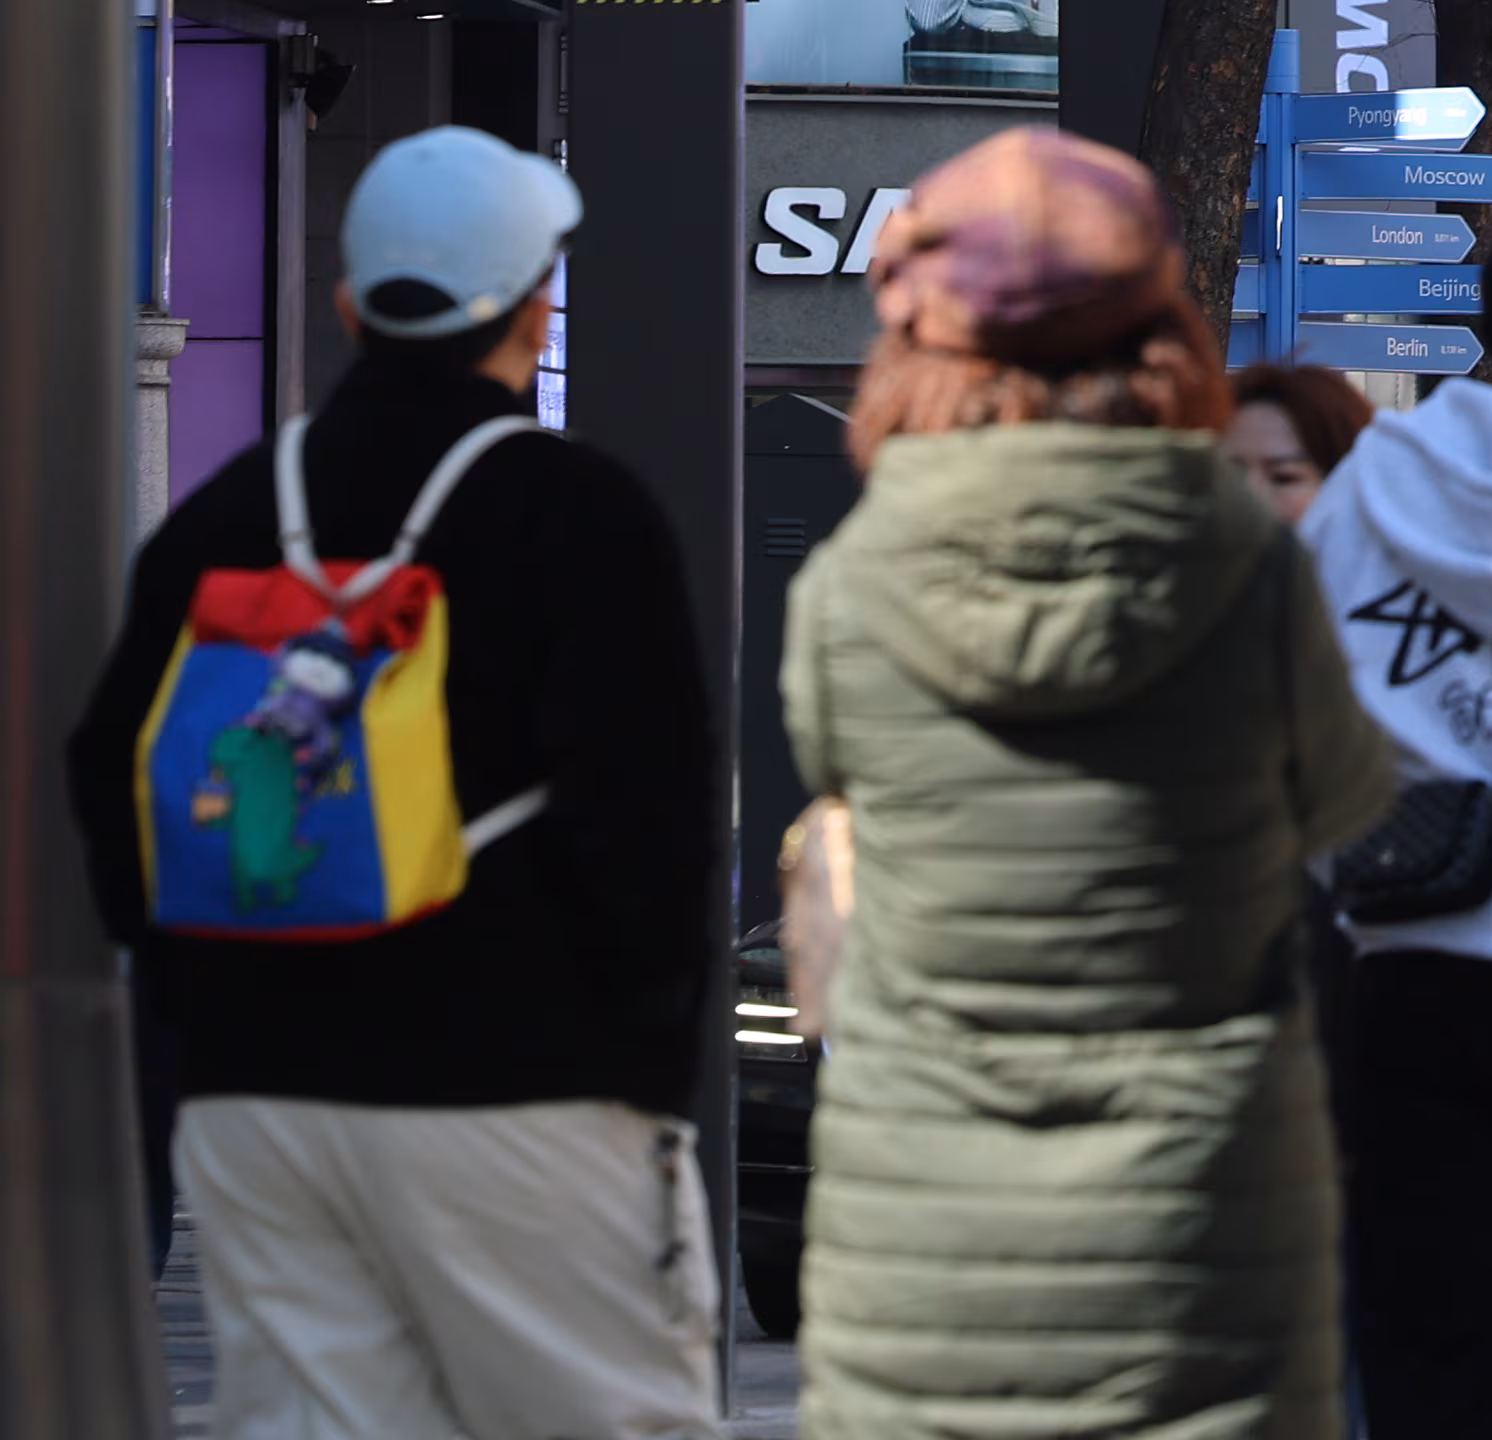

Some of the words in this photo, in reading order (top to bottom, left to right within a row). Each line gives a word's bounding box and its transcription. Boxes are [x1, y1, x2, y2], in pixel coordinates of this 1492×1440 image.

[1348, 106, 1428, 127] Pyongyang
[1404, 165, 1486, 185] Moscow
[1371, 225, 1424, 244] London
[1418, 279, 1481, 301] Beijing
[1386, 337, 1429, 357] Berlin
